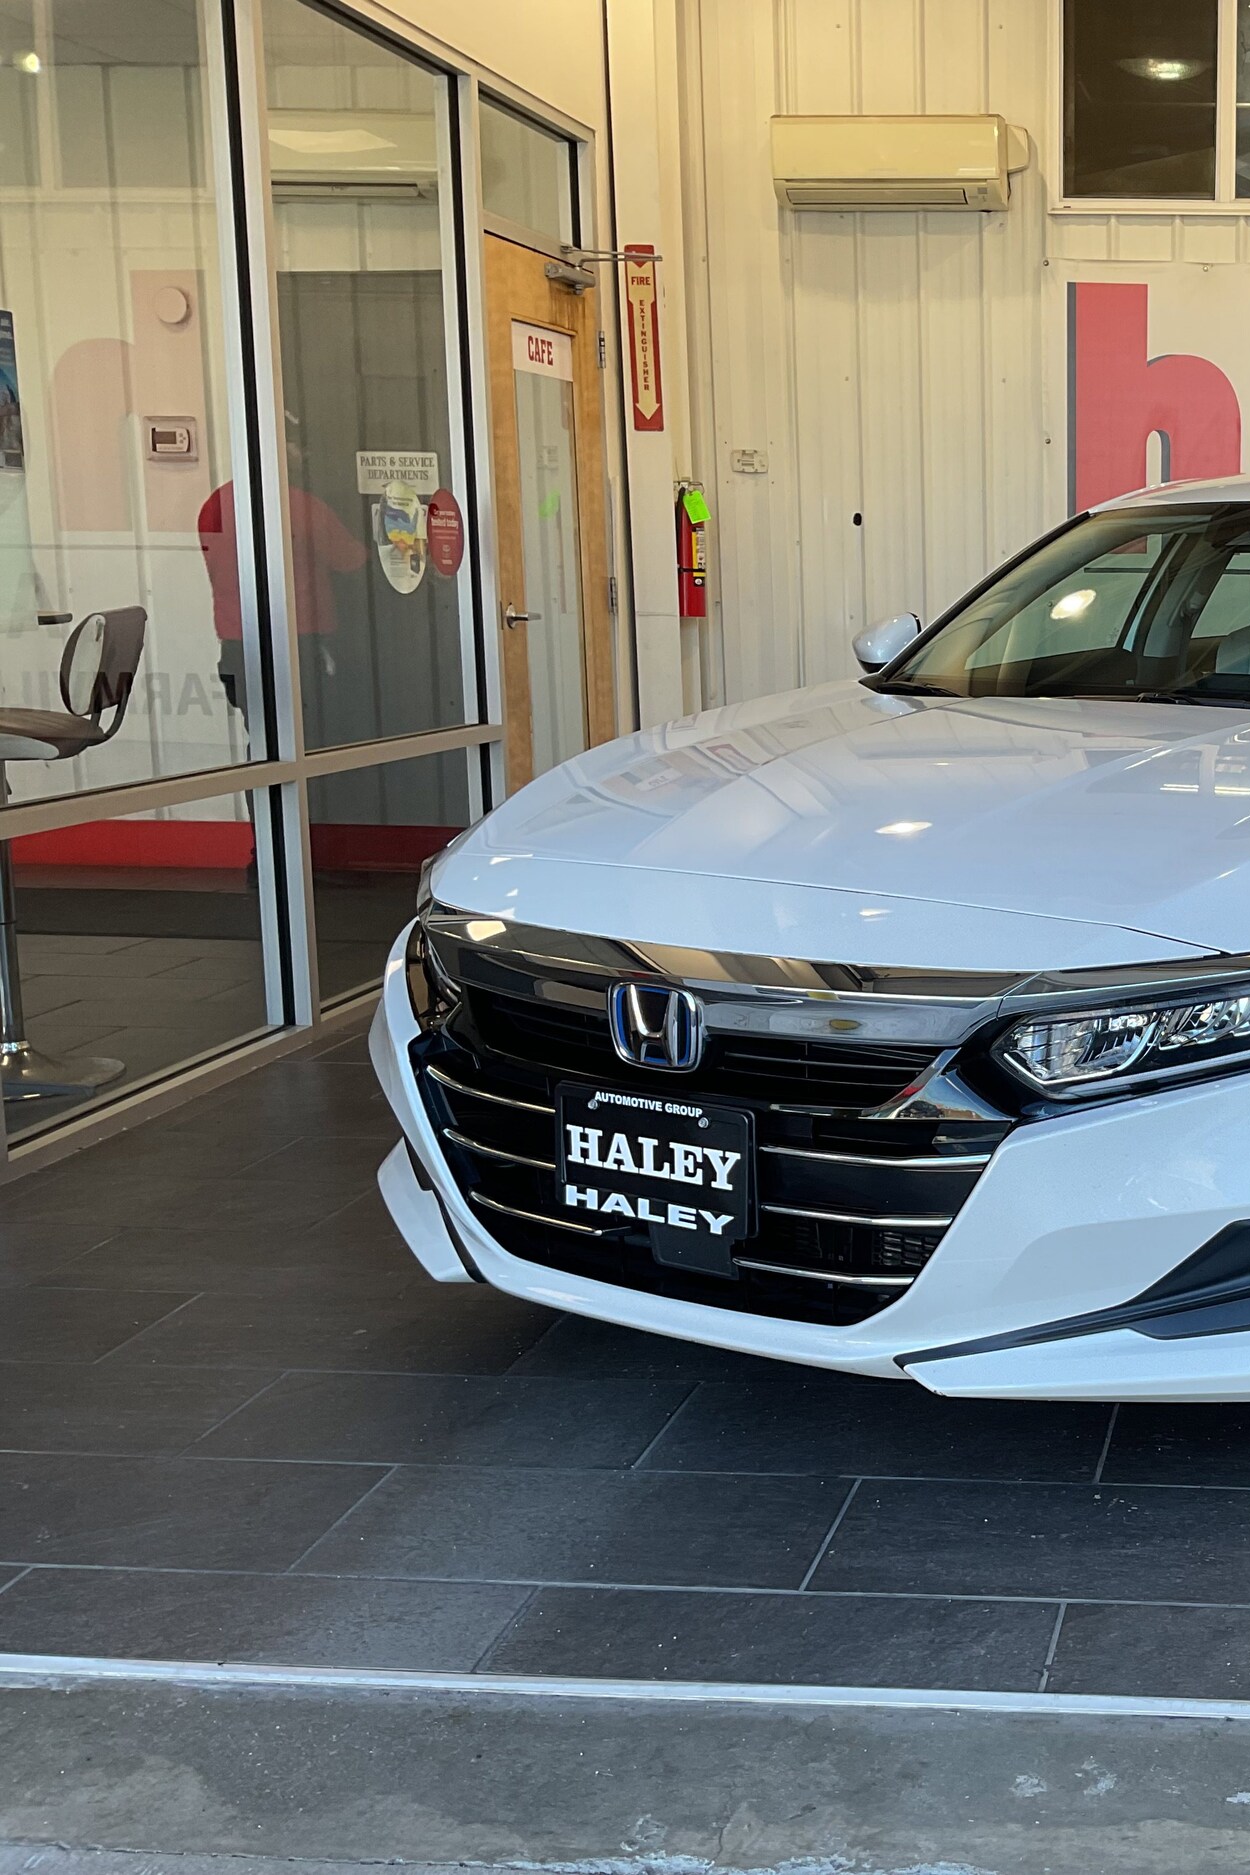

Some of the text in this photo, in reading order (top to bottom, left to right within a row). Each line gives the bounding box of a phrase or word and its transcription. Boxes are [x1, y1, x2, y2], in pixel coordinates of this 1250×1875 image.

[631, 276, 651, 286] FIRE
[527, 335, 554, 366] CAFE
[639, 299, 650, 391] EXTINGUISHER
[360, 456, 435, 468] PARTS & SERVICE
[368, 469, 429, 480] DEPARTMENTS
[594, 1091, 703, 1118] AUTOMOTIVE GROUP
[566, 1124, 741, 1191] HALEY
[565, 1184, 735, 1235] HALEY
